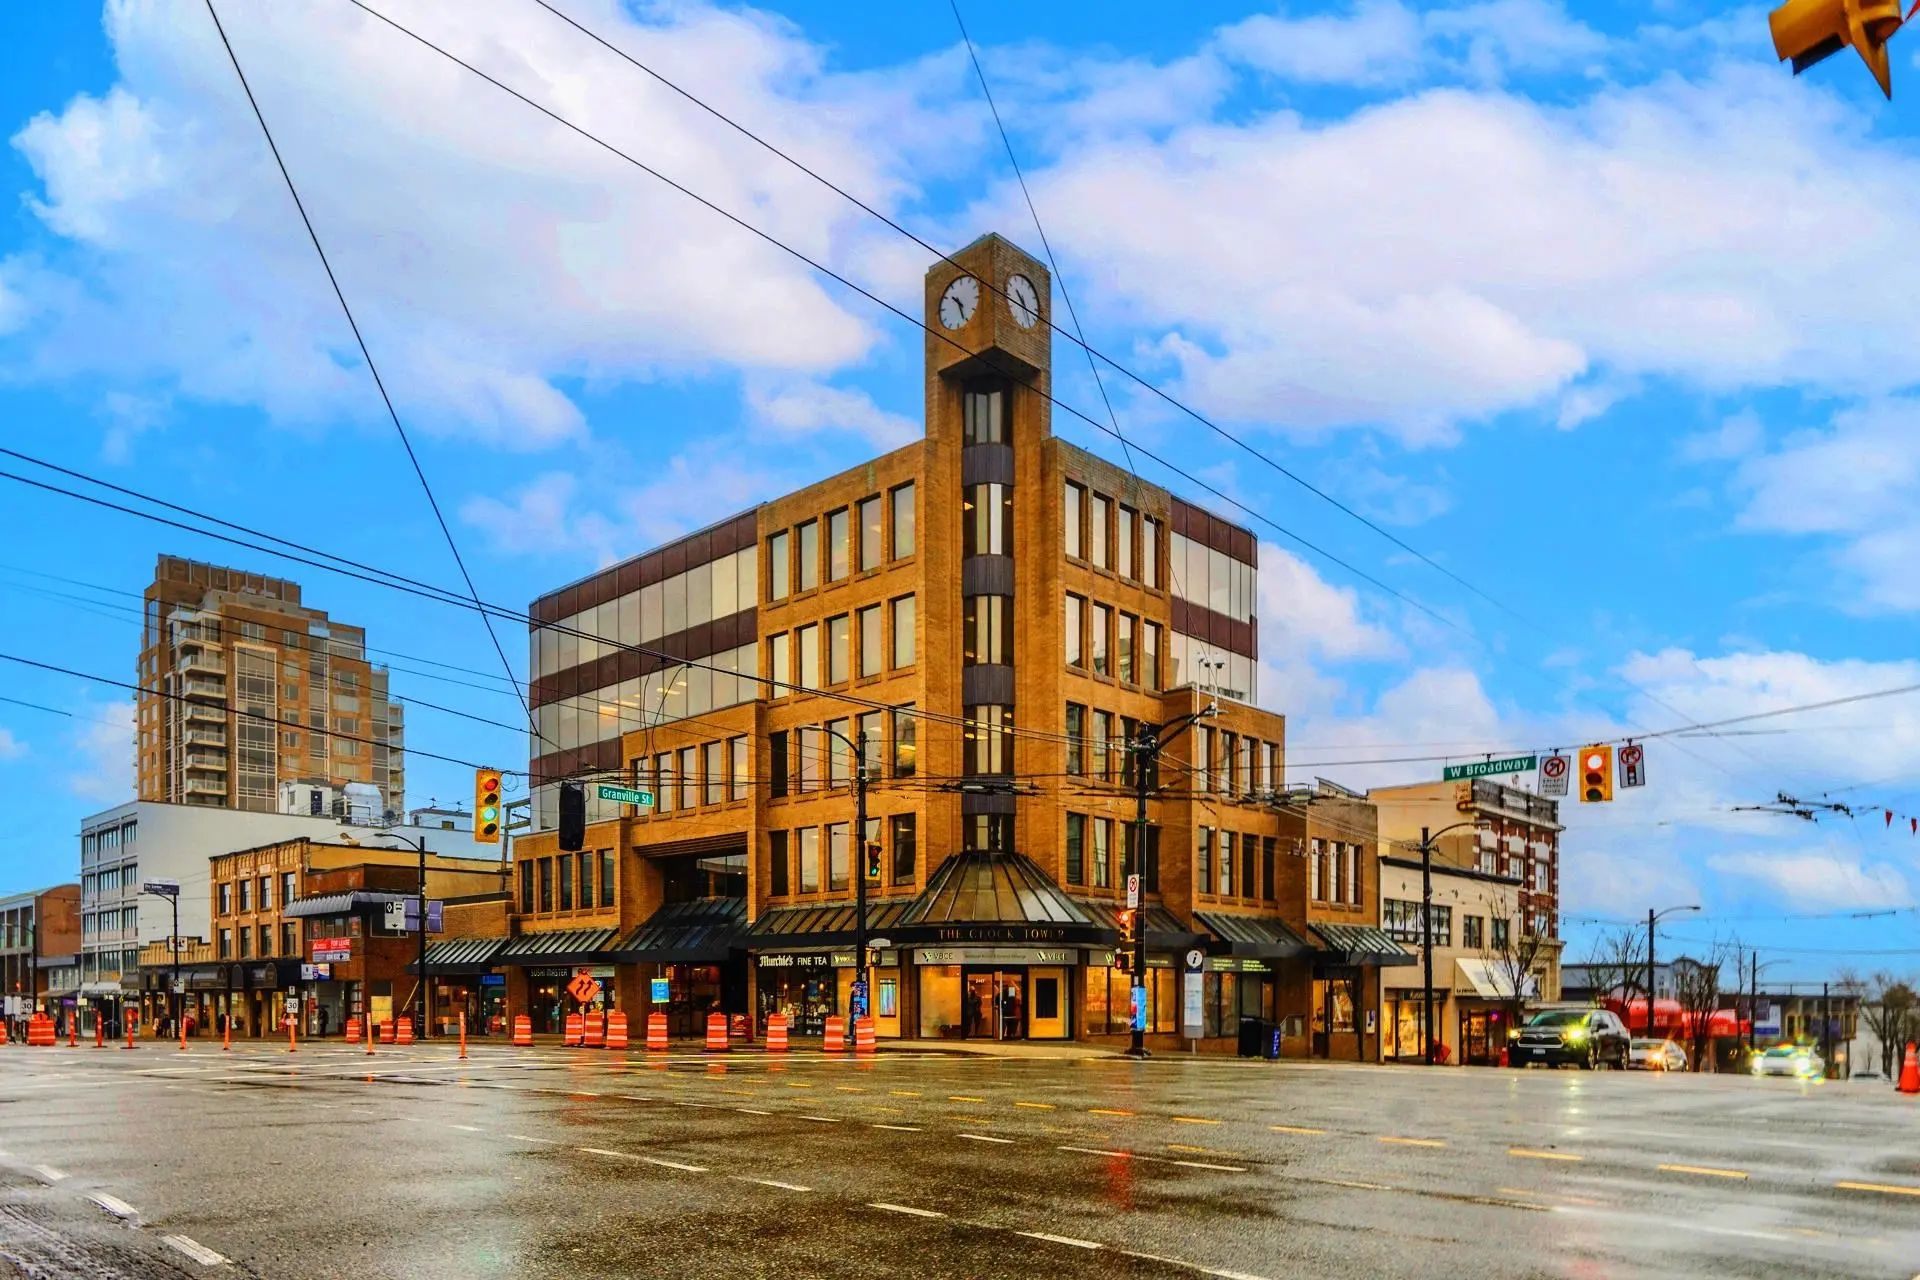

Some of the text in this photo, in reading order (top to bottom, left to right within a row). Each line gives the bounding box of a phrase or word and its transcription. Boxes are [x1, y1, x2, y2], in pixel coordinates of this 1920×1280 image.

[1450, 758, 1529, 778] W Broadway
[602, 788, 650, 804] Granville St
[940, 929, 961, 940] THE
[760, 954, 794, 968] Murchie's
[797, 957, 812, 966] FINE
[814, 956, 828, 966] TEA
[547, 968, 568, 977] MASTER
